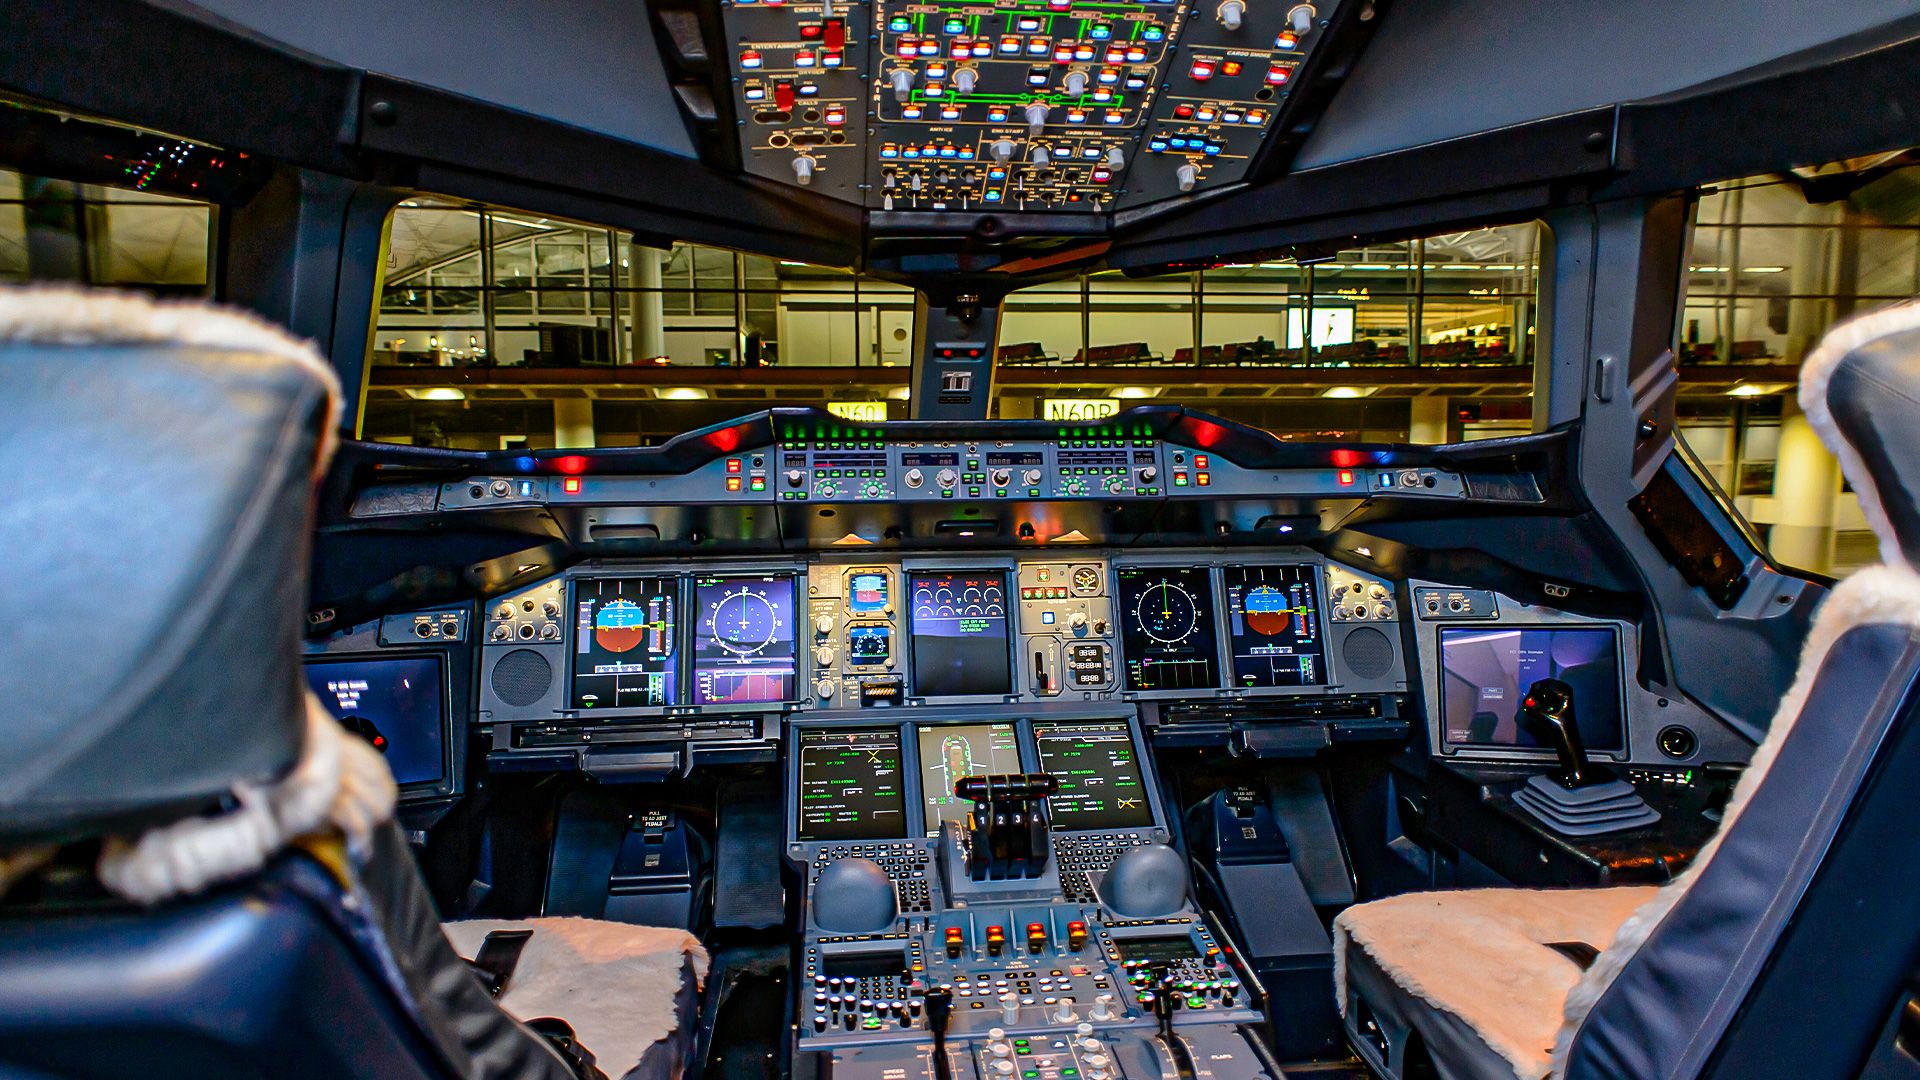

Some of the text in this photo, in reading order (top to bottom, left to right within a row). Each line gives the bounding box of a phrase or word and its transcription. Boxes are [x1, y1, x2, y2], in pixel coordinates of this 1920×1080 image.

[979, 816, 986, 825] 1
[998, 816, 1004, 825] 2
[1015, 814, 1021, 823] 3
[1032, 813, 1039, 823] 4
